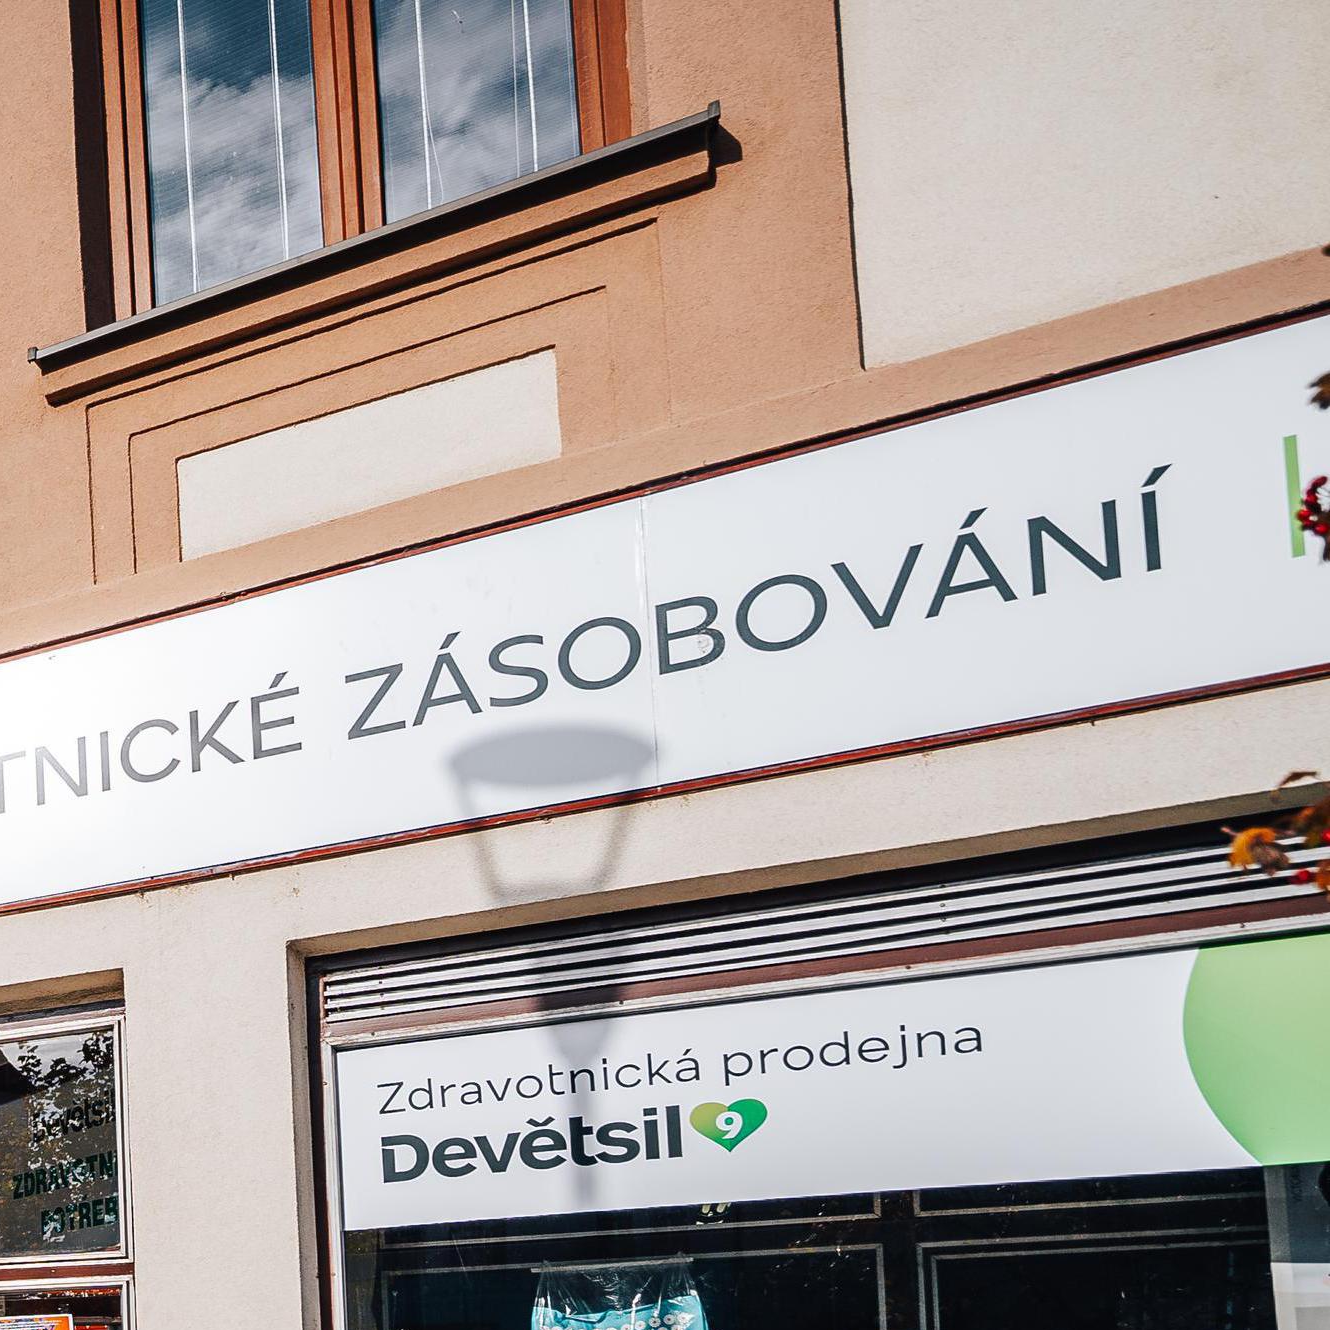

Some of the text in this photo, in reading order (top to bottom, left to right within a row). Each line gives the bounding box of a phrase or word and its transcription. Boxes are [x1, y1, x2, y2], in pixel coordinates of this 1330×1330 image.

[344, 463, 1175, 740] ZÁSOBOVÁNÍ
[376, 1020, 984, 1115] Zdravotnická prodejna
[381, 1103, 682, 1184] Devětsil
